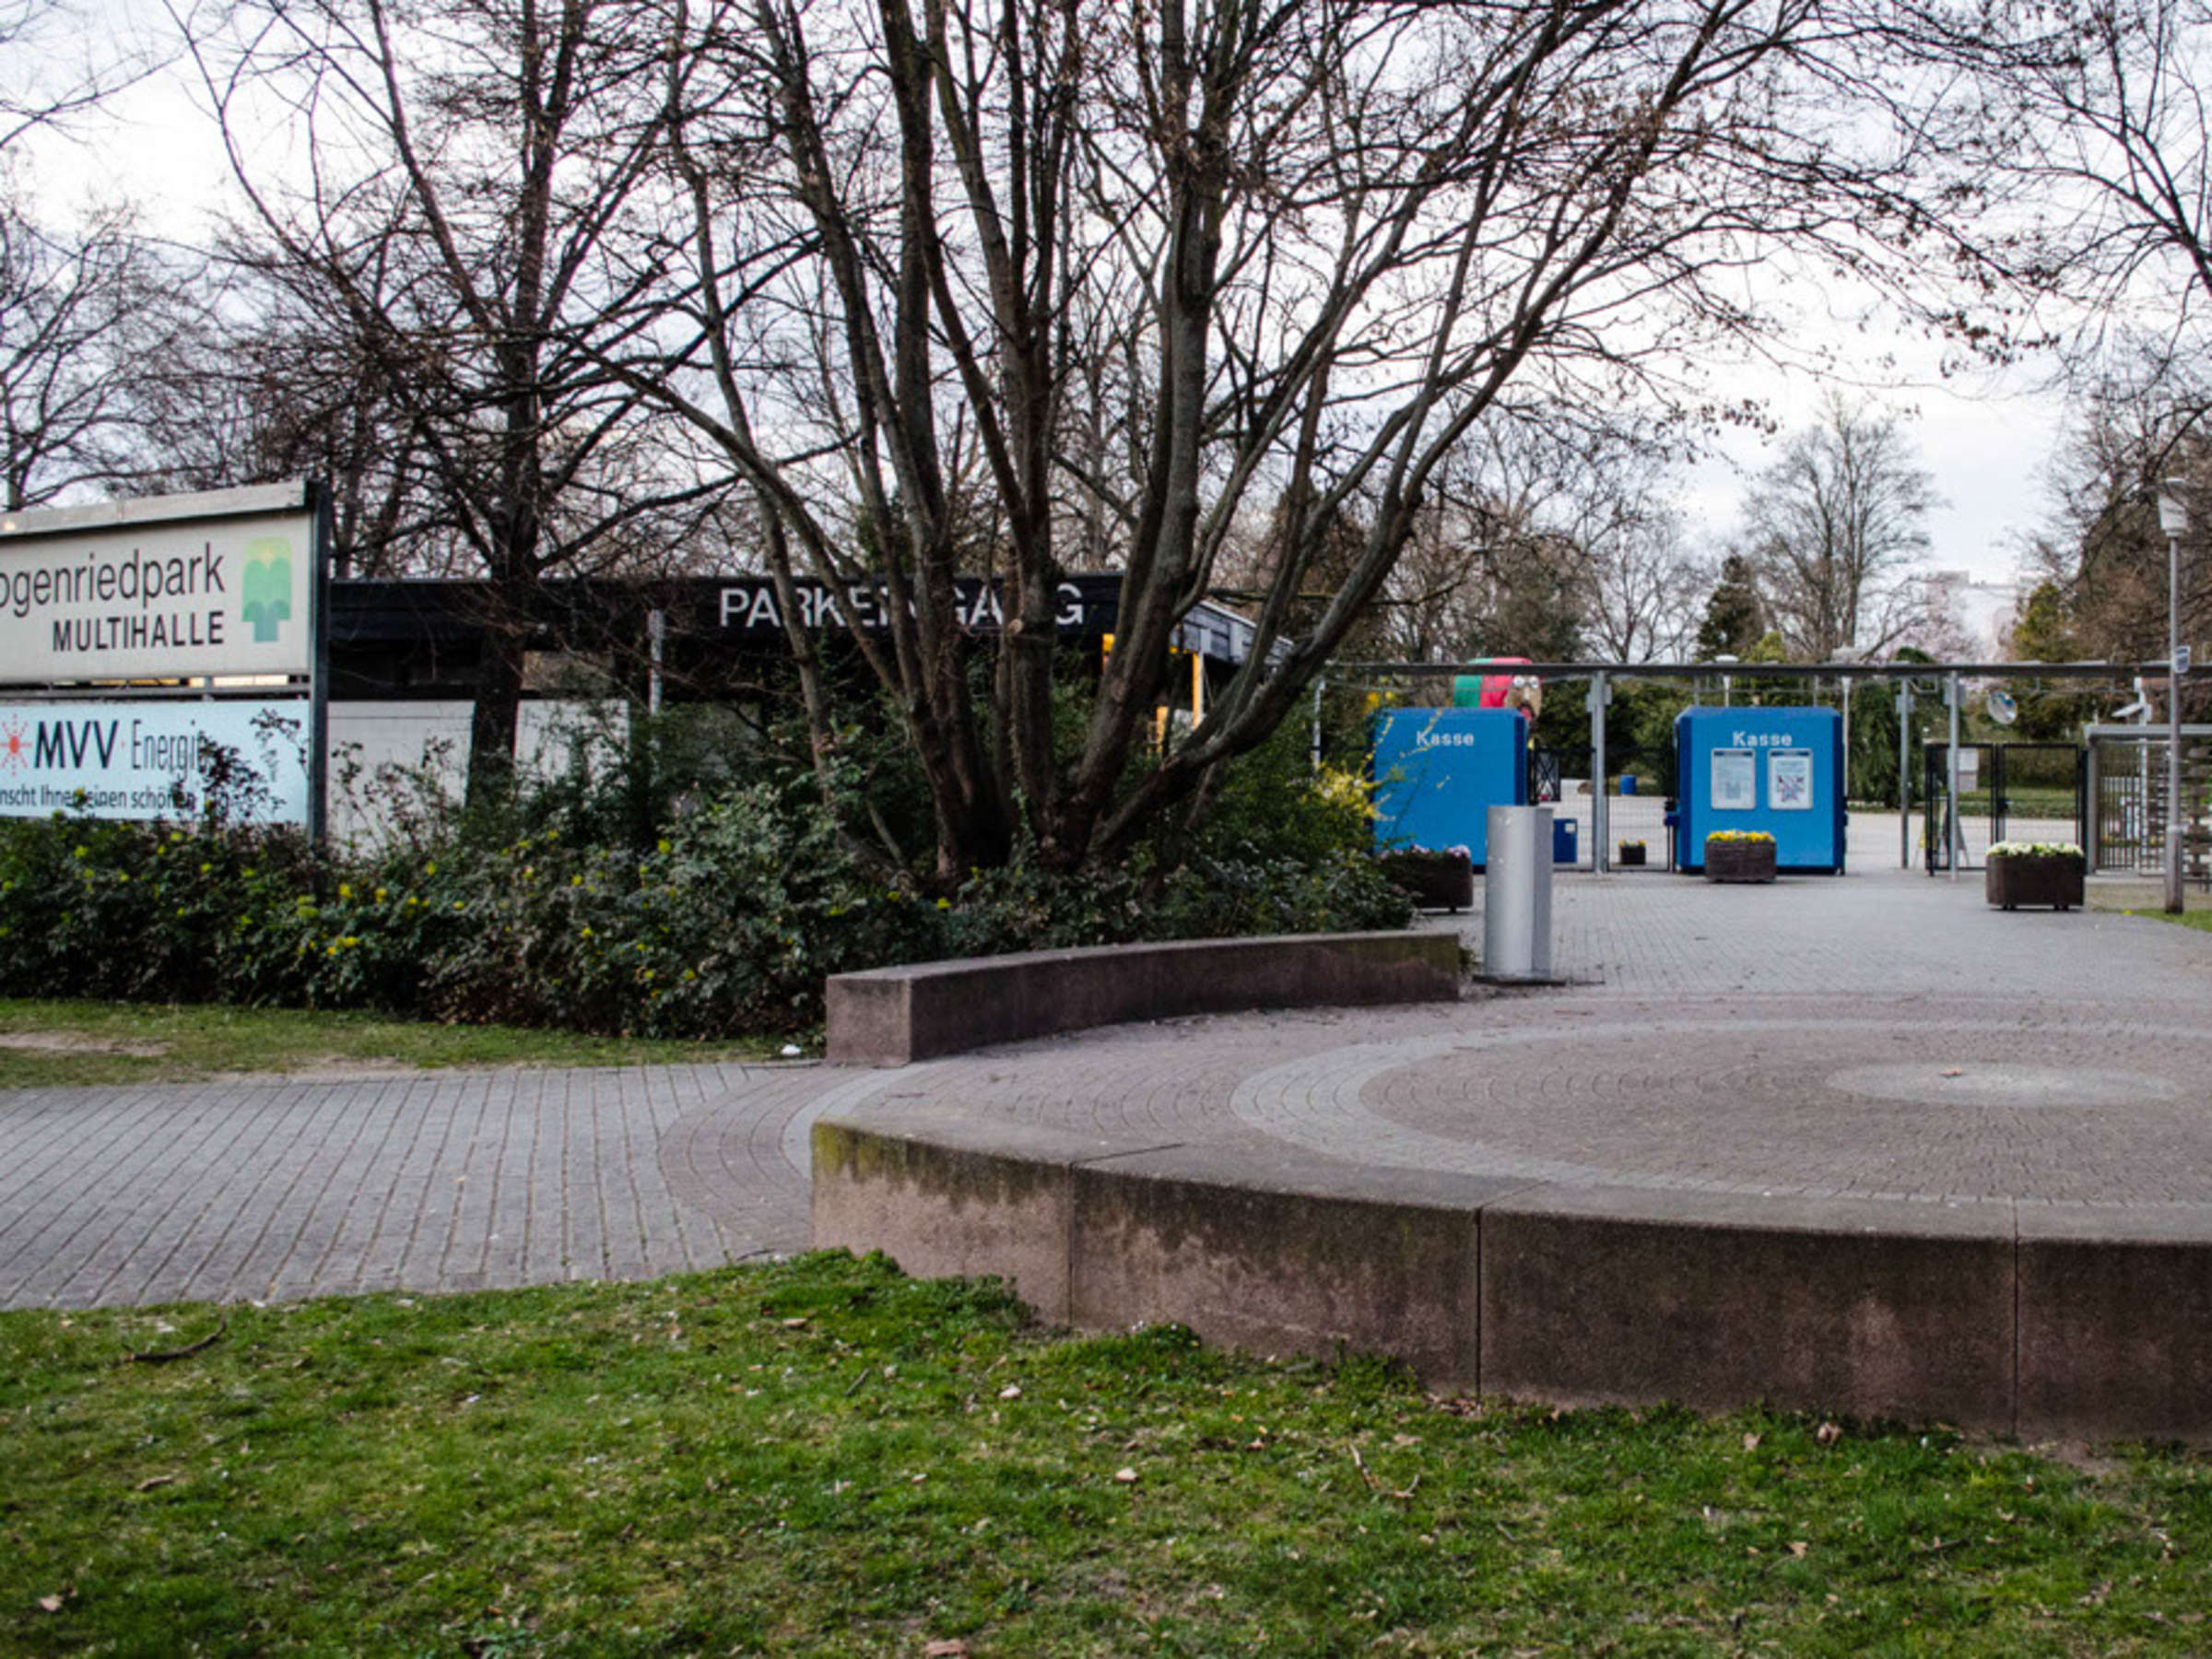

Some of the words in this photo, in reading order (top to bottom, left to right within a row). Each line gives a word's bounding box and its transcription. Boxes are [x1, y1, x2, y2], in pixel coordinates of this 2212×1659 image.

[53, 611, 224, 652] MULTIHALLE
[34, 720, 119, 768] MVV
[1417, 730, 1474, 747] Kasse
[1733, 731, 1793, 747] Kasse
